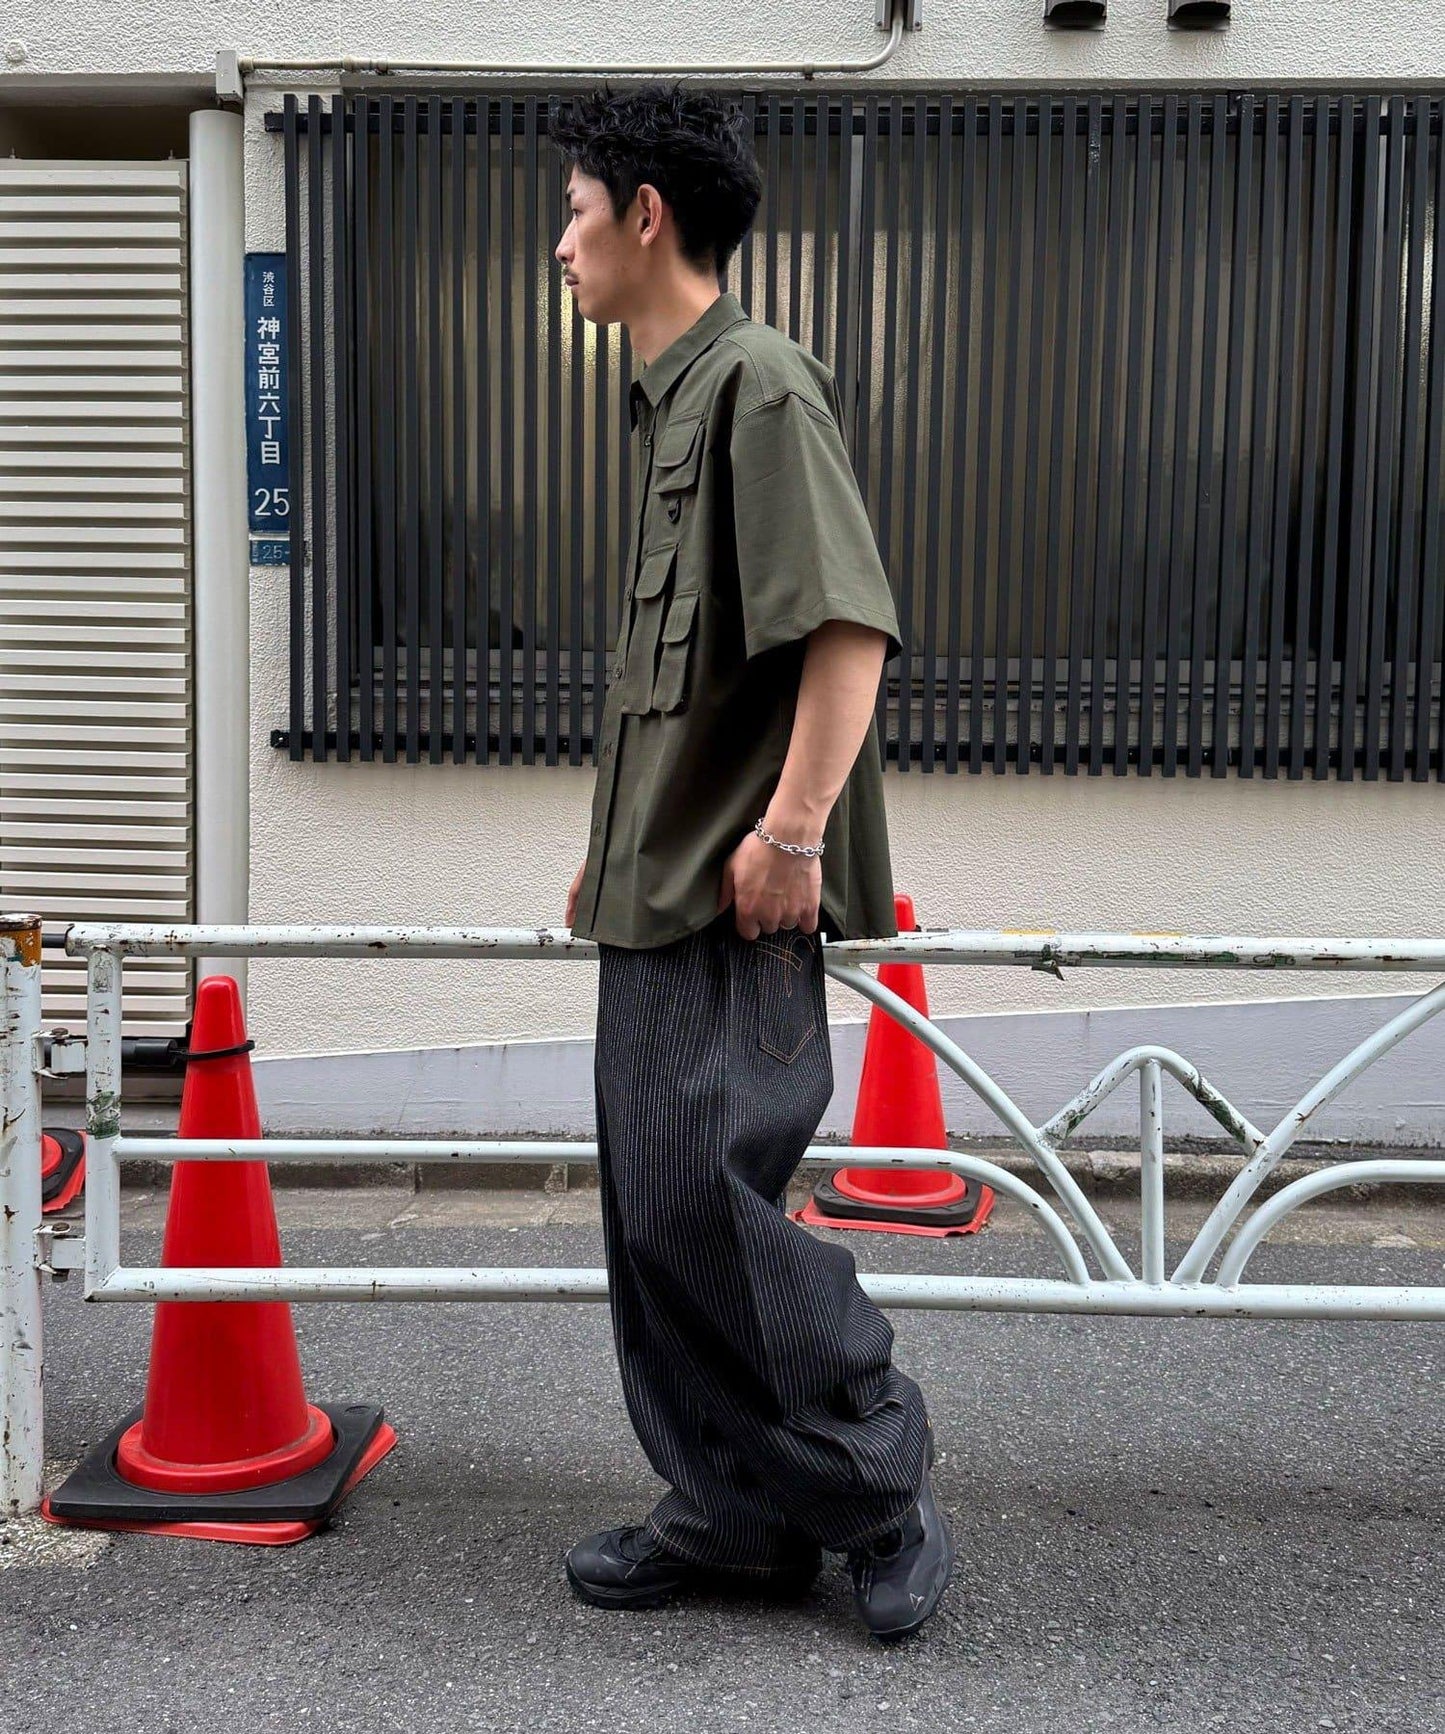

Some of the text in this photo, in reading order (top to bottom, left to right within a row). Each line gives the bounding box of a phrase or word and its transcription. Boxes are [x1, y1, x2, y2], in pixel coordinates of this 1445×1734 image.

[262, 271, 275, 307] 渋谷区
[257, 316, 281, 465] 神宮前六丁目
[254, 488, 290, 516] 25
